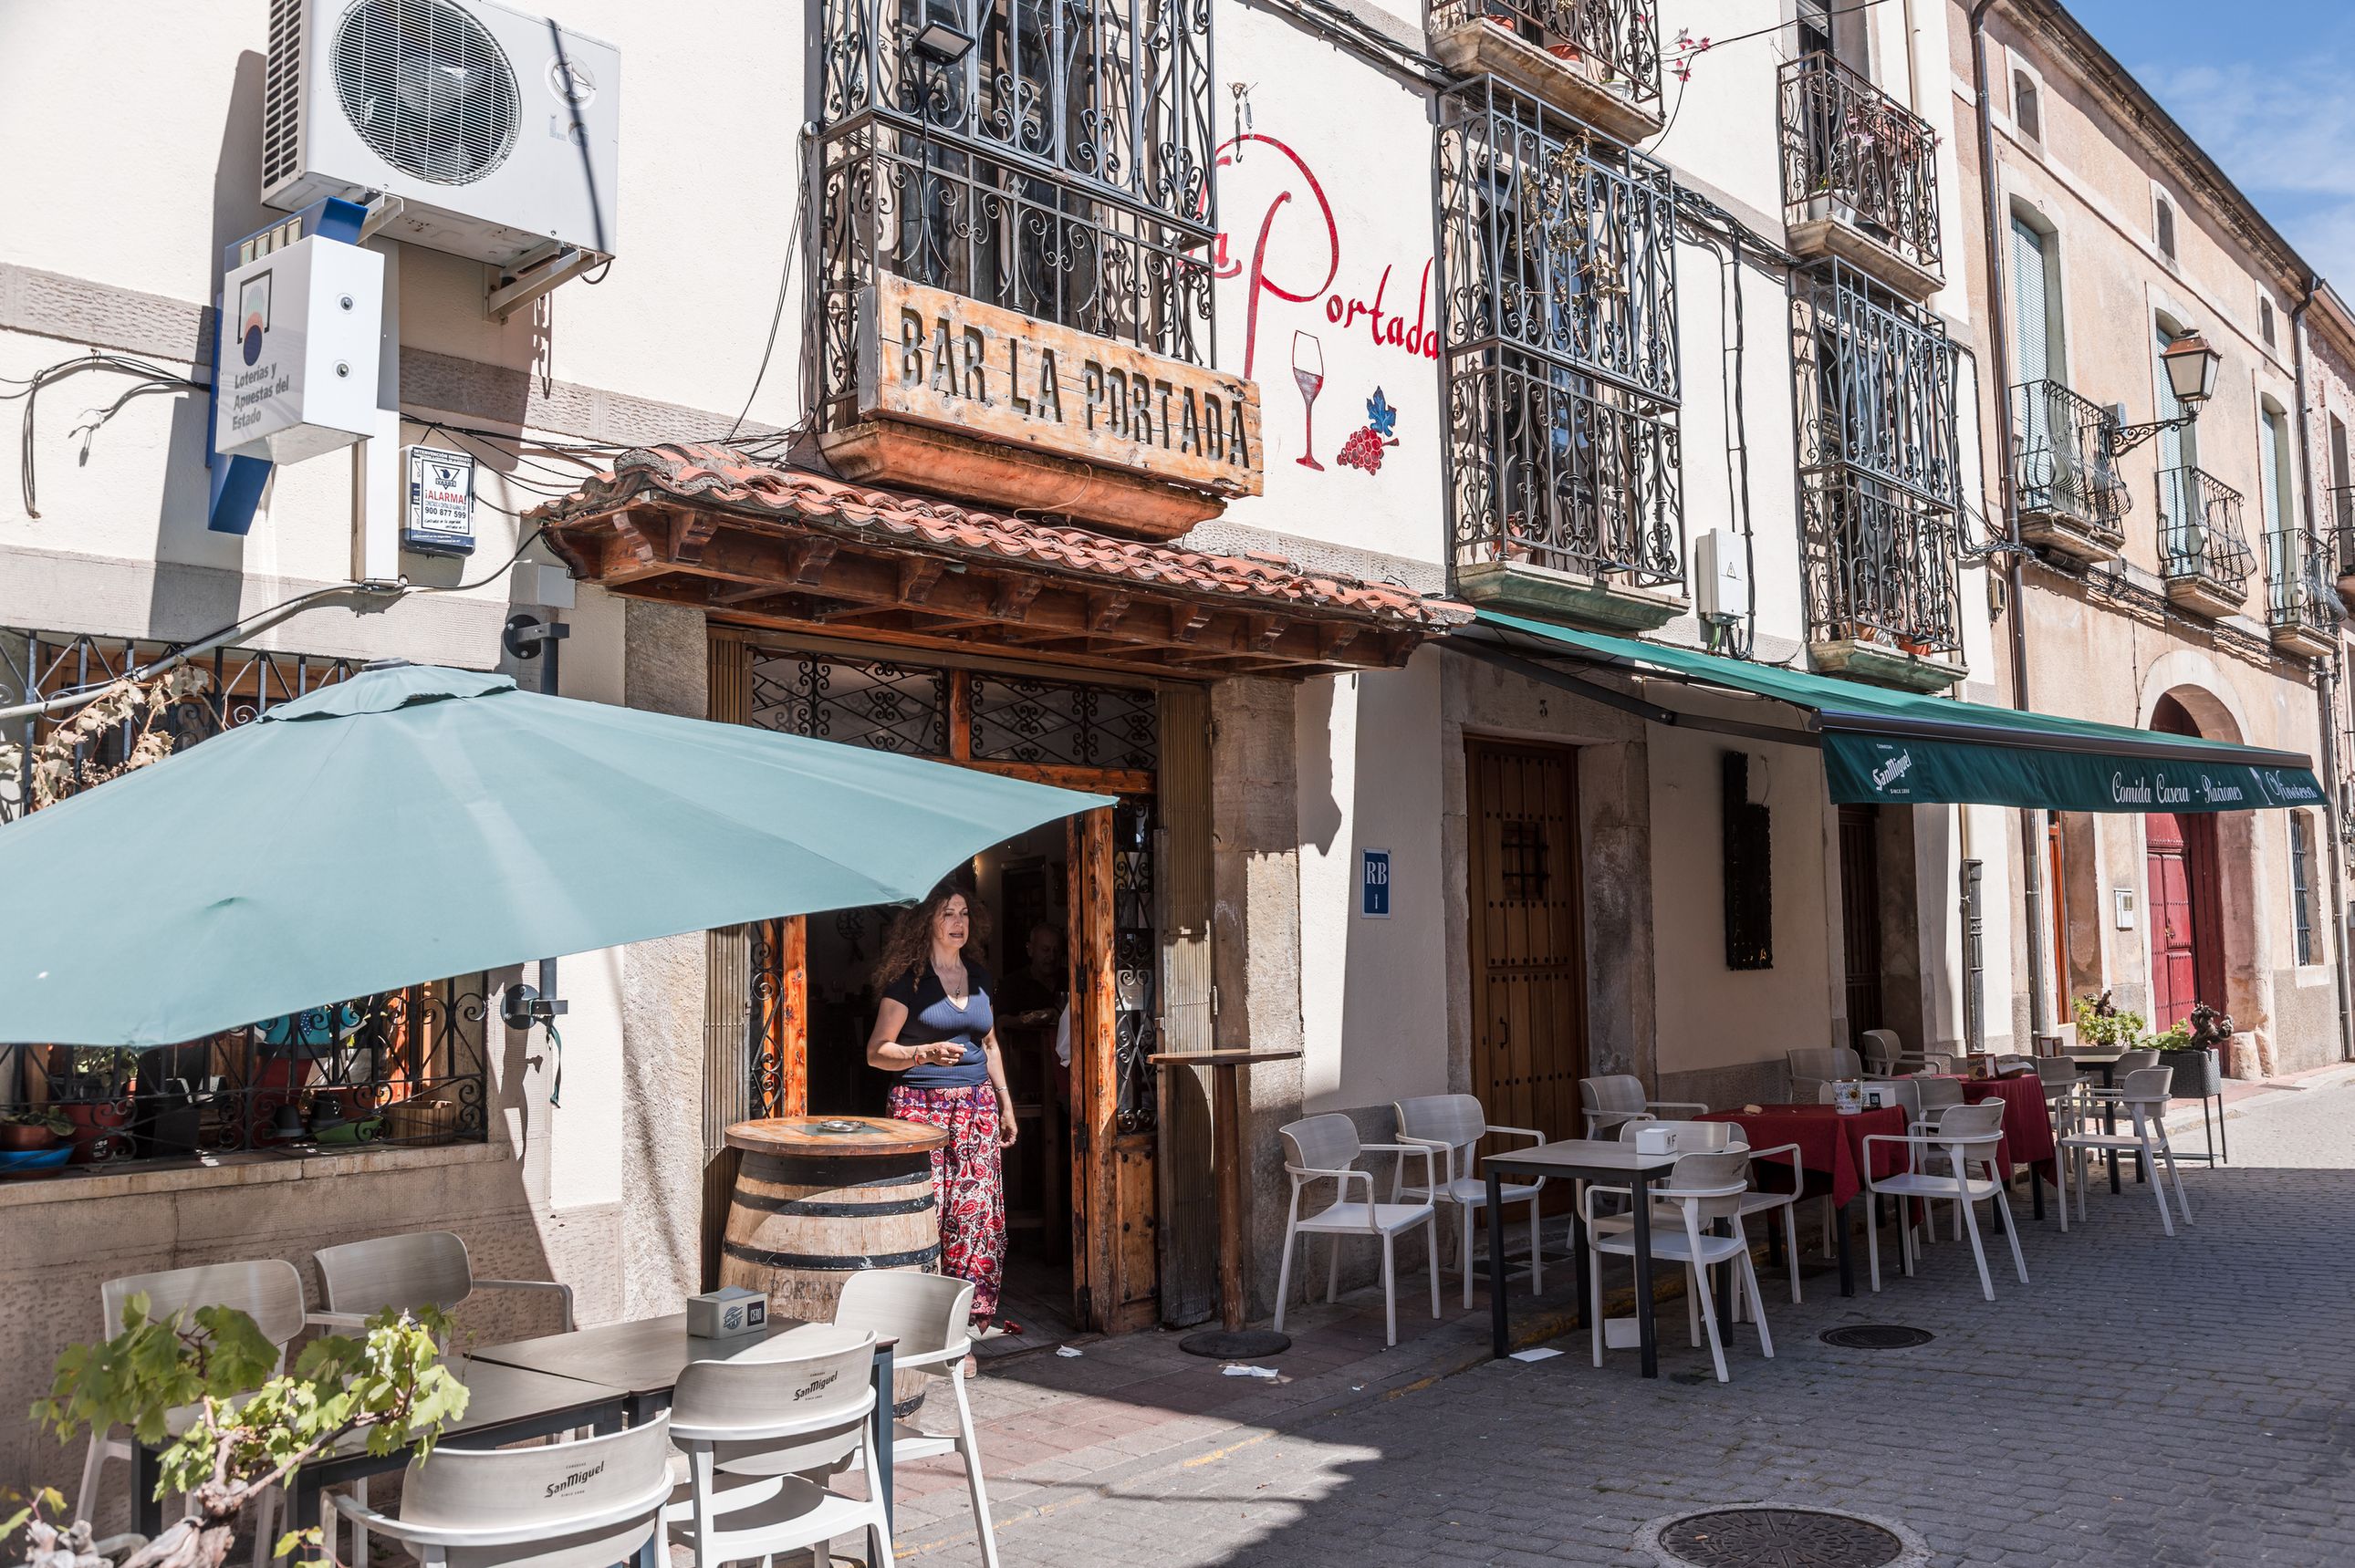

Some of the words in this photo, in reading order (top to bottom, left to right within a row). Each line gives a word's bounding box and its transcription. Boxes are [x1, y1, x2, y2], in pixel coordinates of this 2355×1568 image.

[1215, 134, 1441, 379] Portada
[271, 362, 276, 379] y
[234, 385, 273, 411] Apuestas
[276, 374, 289, 395] del
[901, 306, 985, 403] BAR
[1010, 337, 1063, 423] LA
[1085, 358, 1250, 469] PORTADA
[233, 408, 261, 431] Estado
[453, 511, 466, 519] 599
[2112, 772, 2151, 803] Comida
[2156, 774, 2190, 804] Casera
[2201, 774, 2243, 804] Raciones
[1366, 861, 1387, 885] RB
